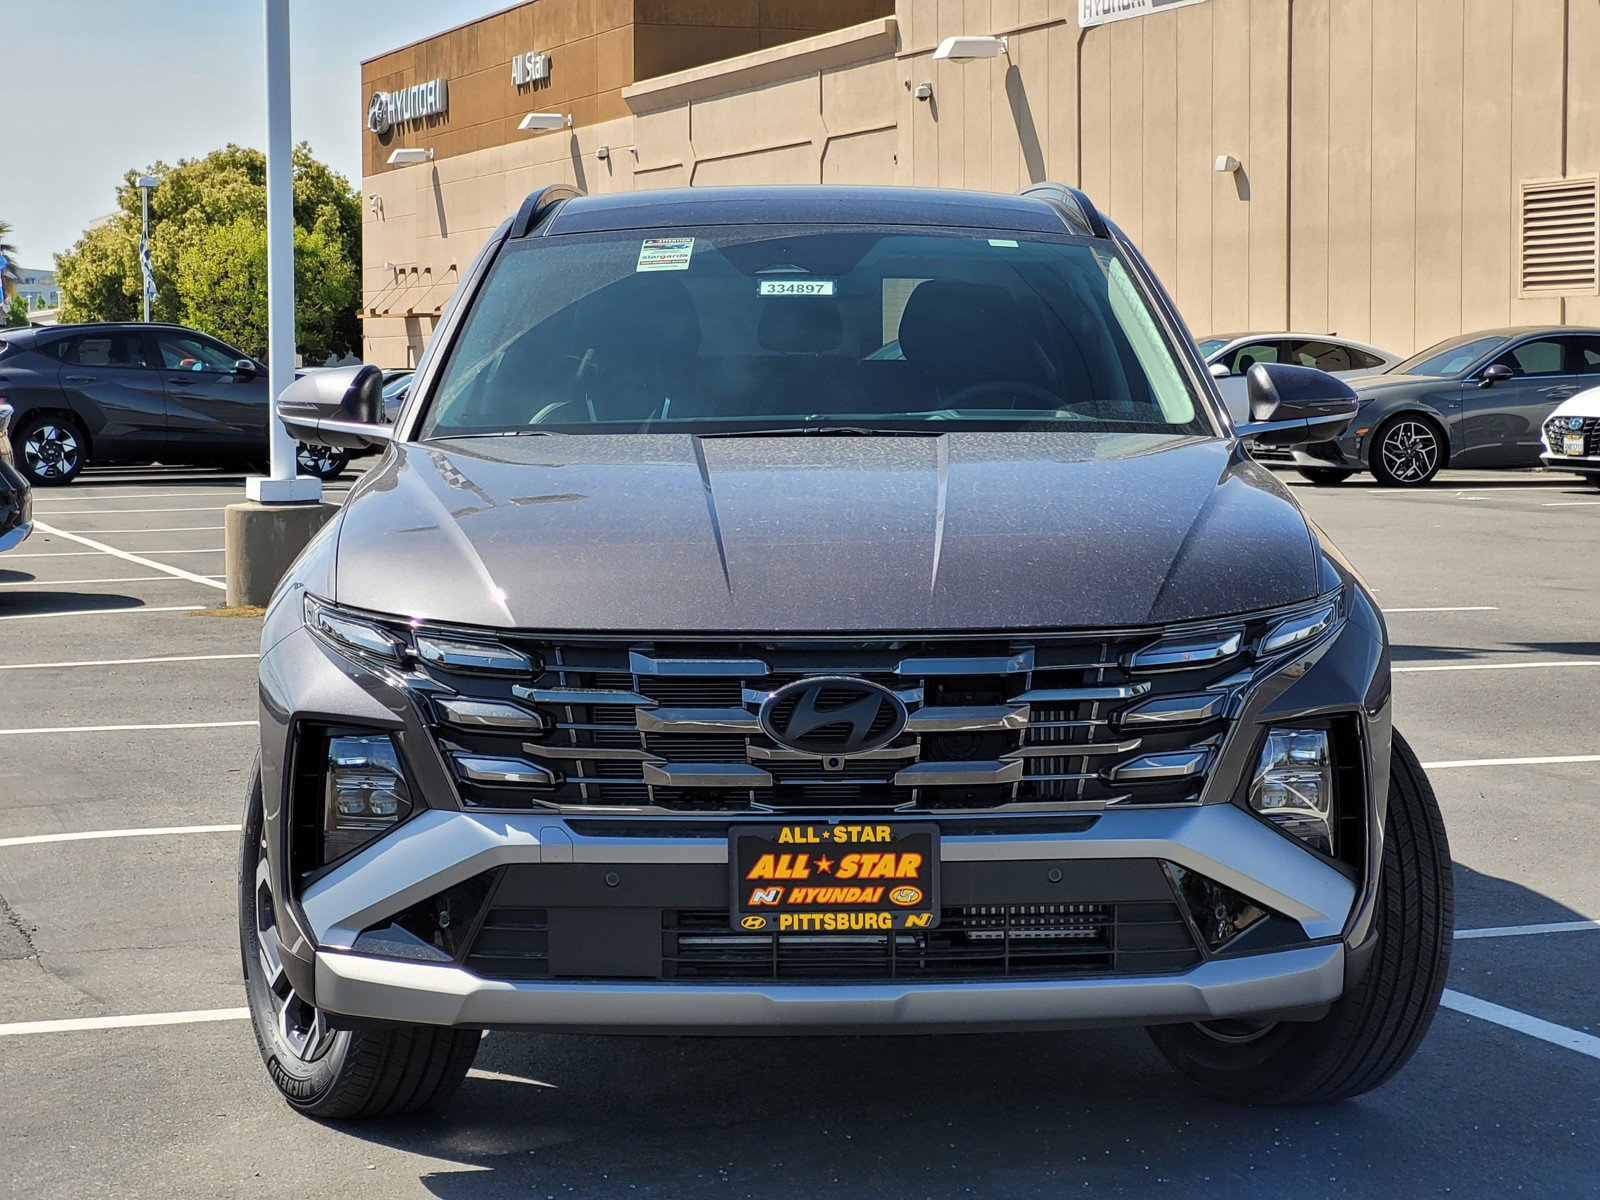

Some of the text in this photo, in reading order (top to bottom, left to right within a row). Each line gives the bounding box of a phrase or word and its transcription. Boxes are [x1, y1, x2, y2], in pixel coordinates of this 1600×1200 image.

[511, 51, 551, 86] All Star
[387, 77, 446, 124] HYUNDAI
[766, 283, 825, 294] 334897
[778, 826, 891, 844] ALL STAR
[746, 852, 923, 880] ALL STAR
[787, 886, 886, 904] HYUNDAI
[779, 912, 892, 931] PITTSBURG
[268, 1059, 312, 1097] MICHELIN
